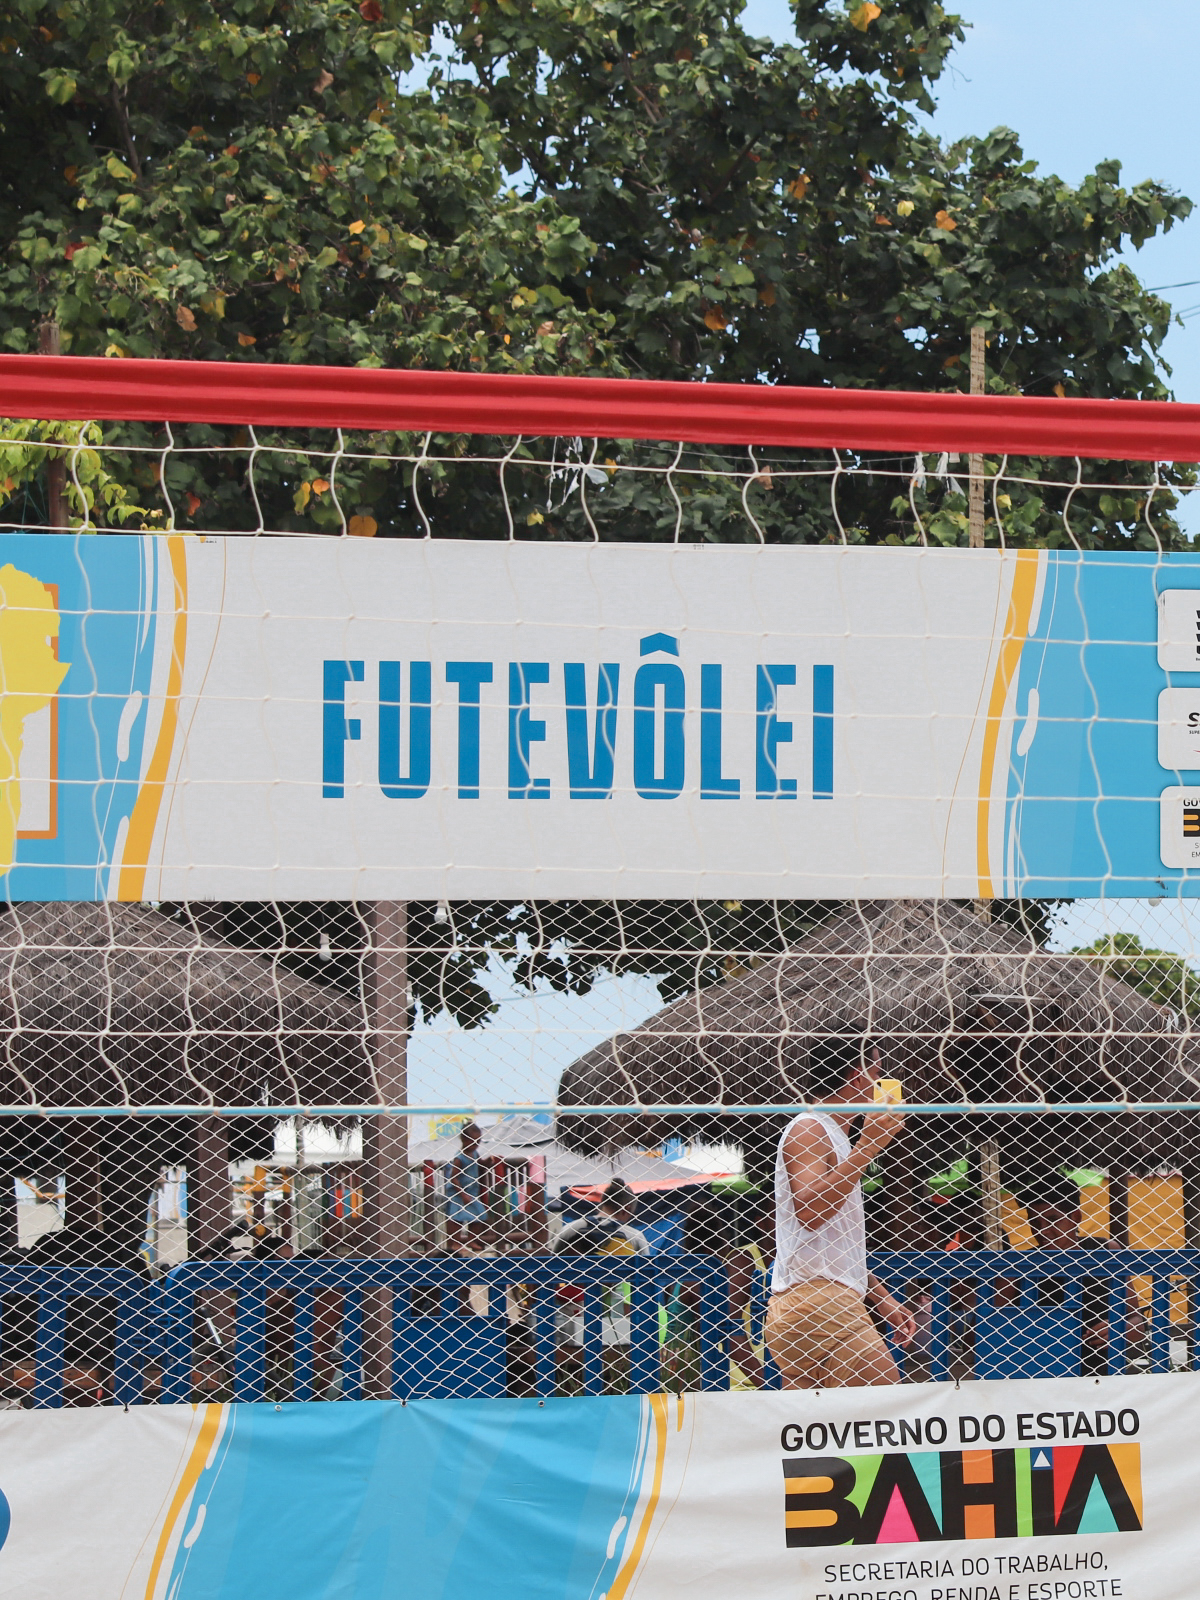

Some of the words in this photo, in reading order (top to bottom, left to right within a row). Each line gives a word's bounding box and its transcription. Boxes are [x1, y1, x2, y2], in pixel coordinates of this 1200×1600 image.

[322, 632, 834, 800] FUTEVÔLEI
[780, 1416, 948, 1452] GOVERNO
[958, 1413, 1006, 1444] DO
[1016, 1408, 1141, 1441] ESTADO
[782, 1442, 1143, 1549] BAHIA
[824, 1559, 955, 1583] SECRETARIA
[961, 1557, 989, 1577] DO
[994, 1551, 1108, 1575] TRABALHO,
[931, 1585, 1001, 1600] RENDA
[1009, 1584, 1020, 1600] E
[1028, 1578, 1123, 1600] ESPORTE
